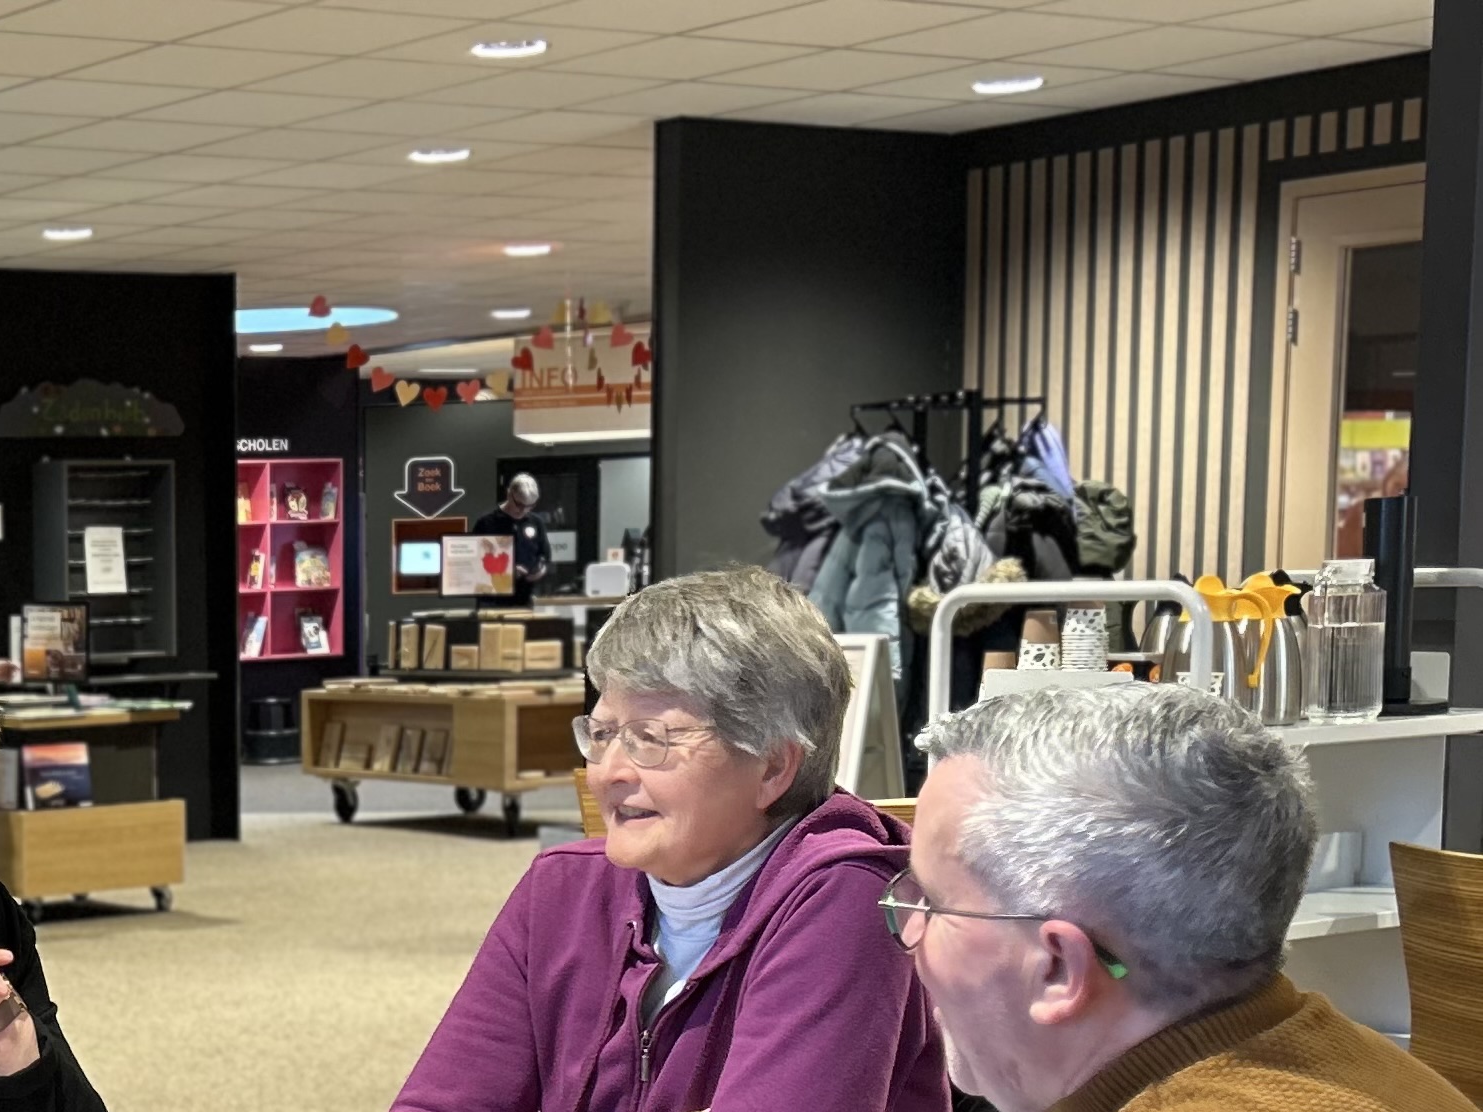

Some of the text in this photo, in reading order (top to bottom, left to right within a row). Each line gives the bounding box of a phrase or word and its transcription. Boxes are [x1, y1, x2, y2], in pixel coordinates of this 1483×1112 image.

[521, 366, 578, 389] INFO
[418, 468, 441, 477] Zoek
[418, 482, 442, 492] Boek
